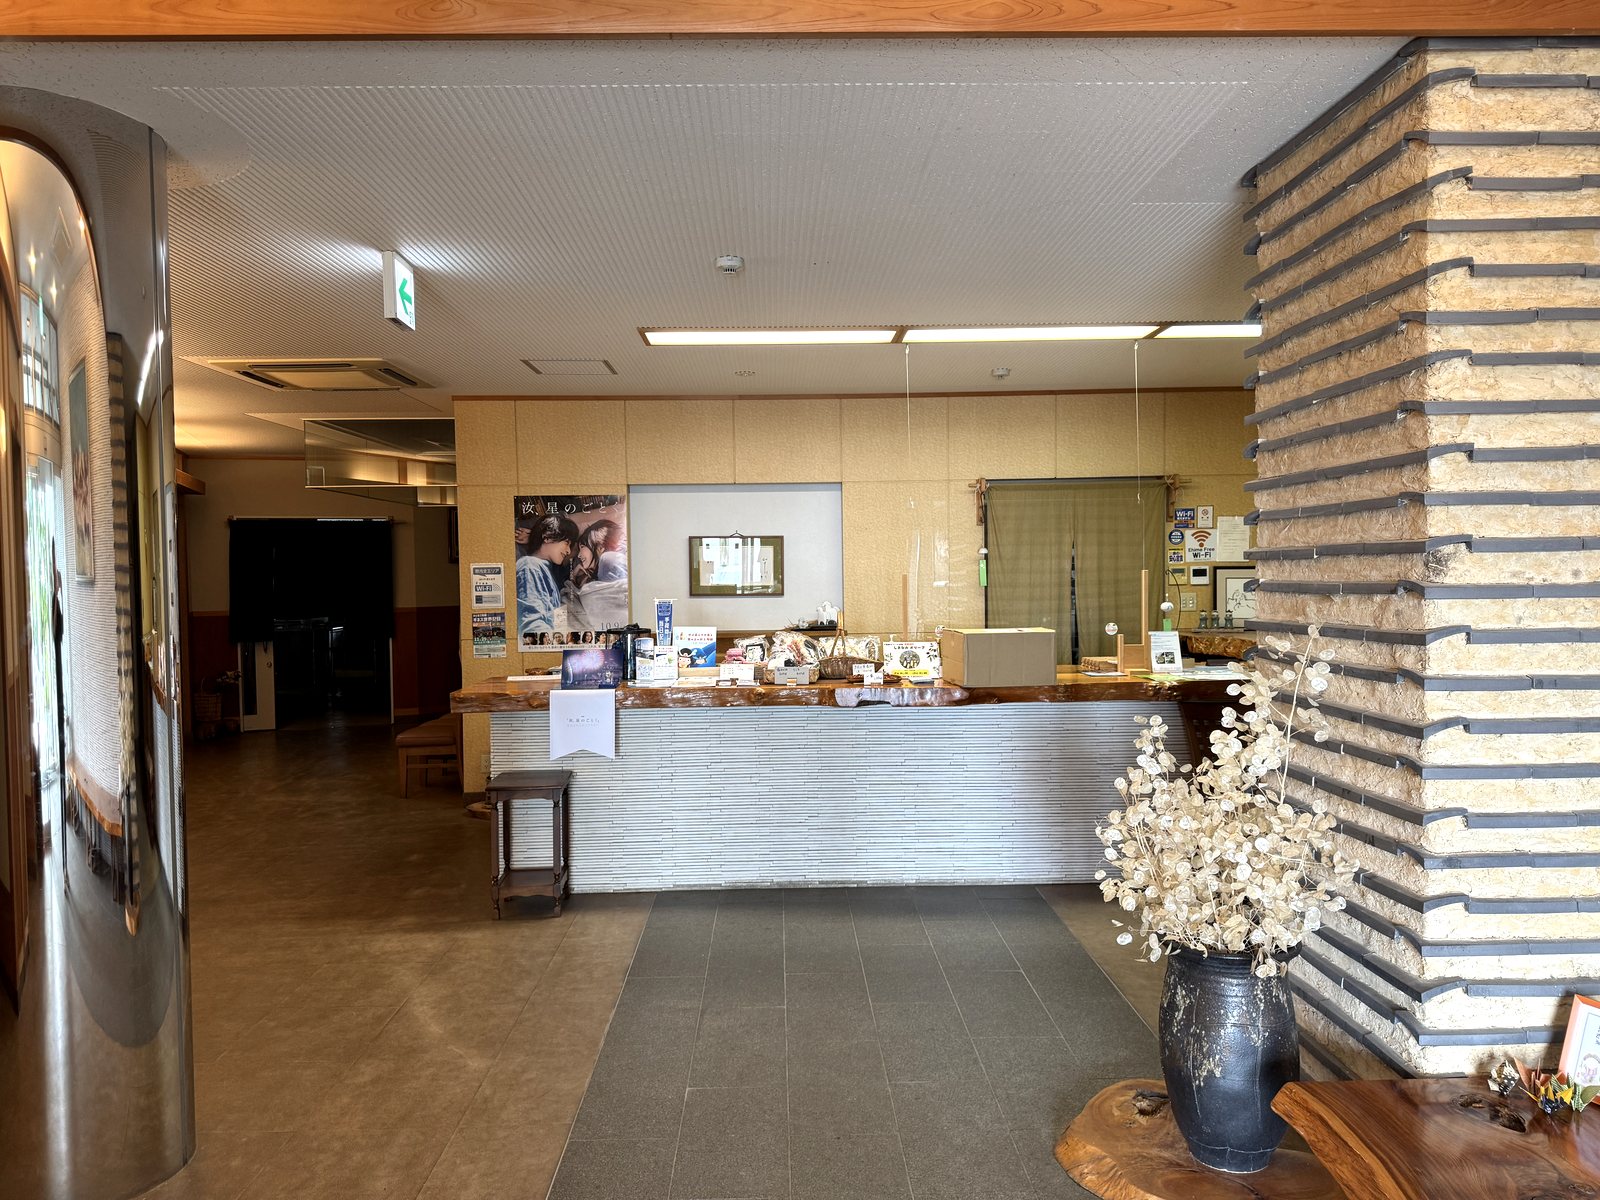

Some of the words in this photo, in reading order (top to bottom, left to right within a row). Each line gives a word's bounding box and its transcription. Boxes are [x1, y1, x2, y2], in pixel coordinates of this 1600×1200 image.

[521, 501, 618, 515] 汝、星のごとく
